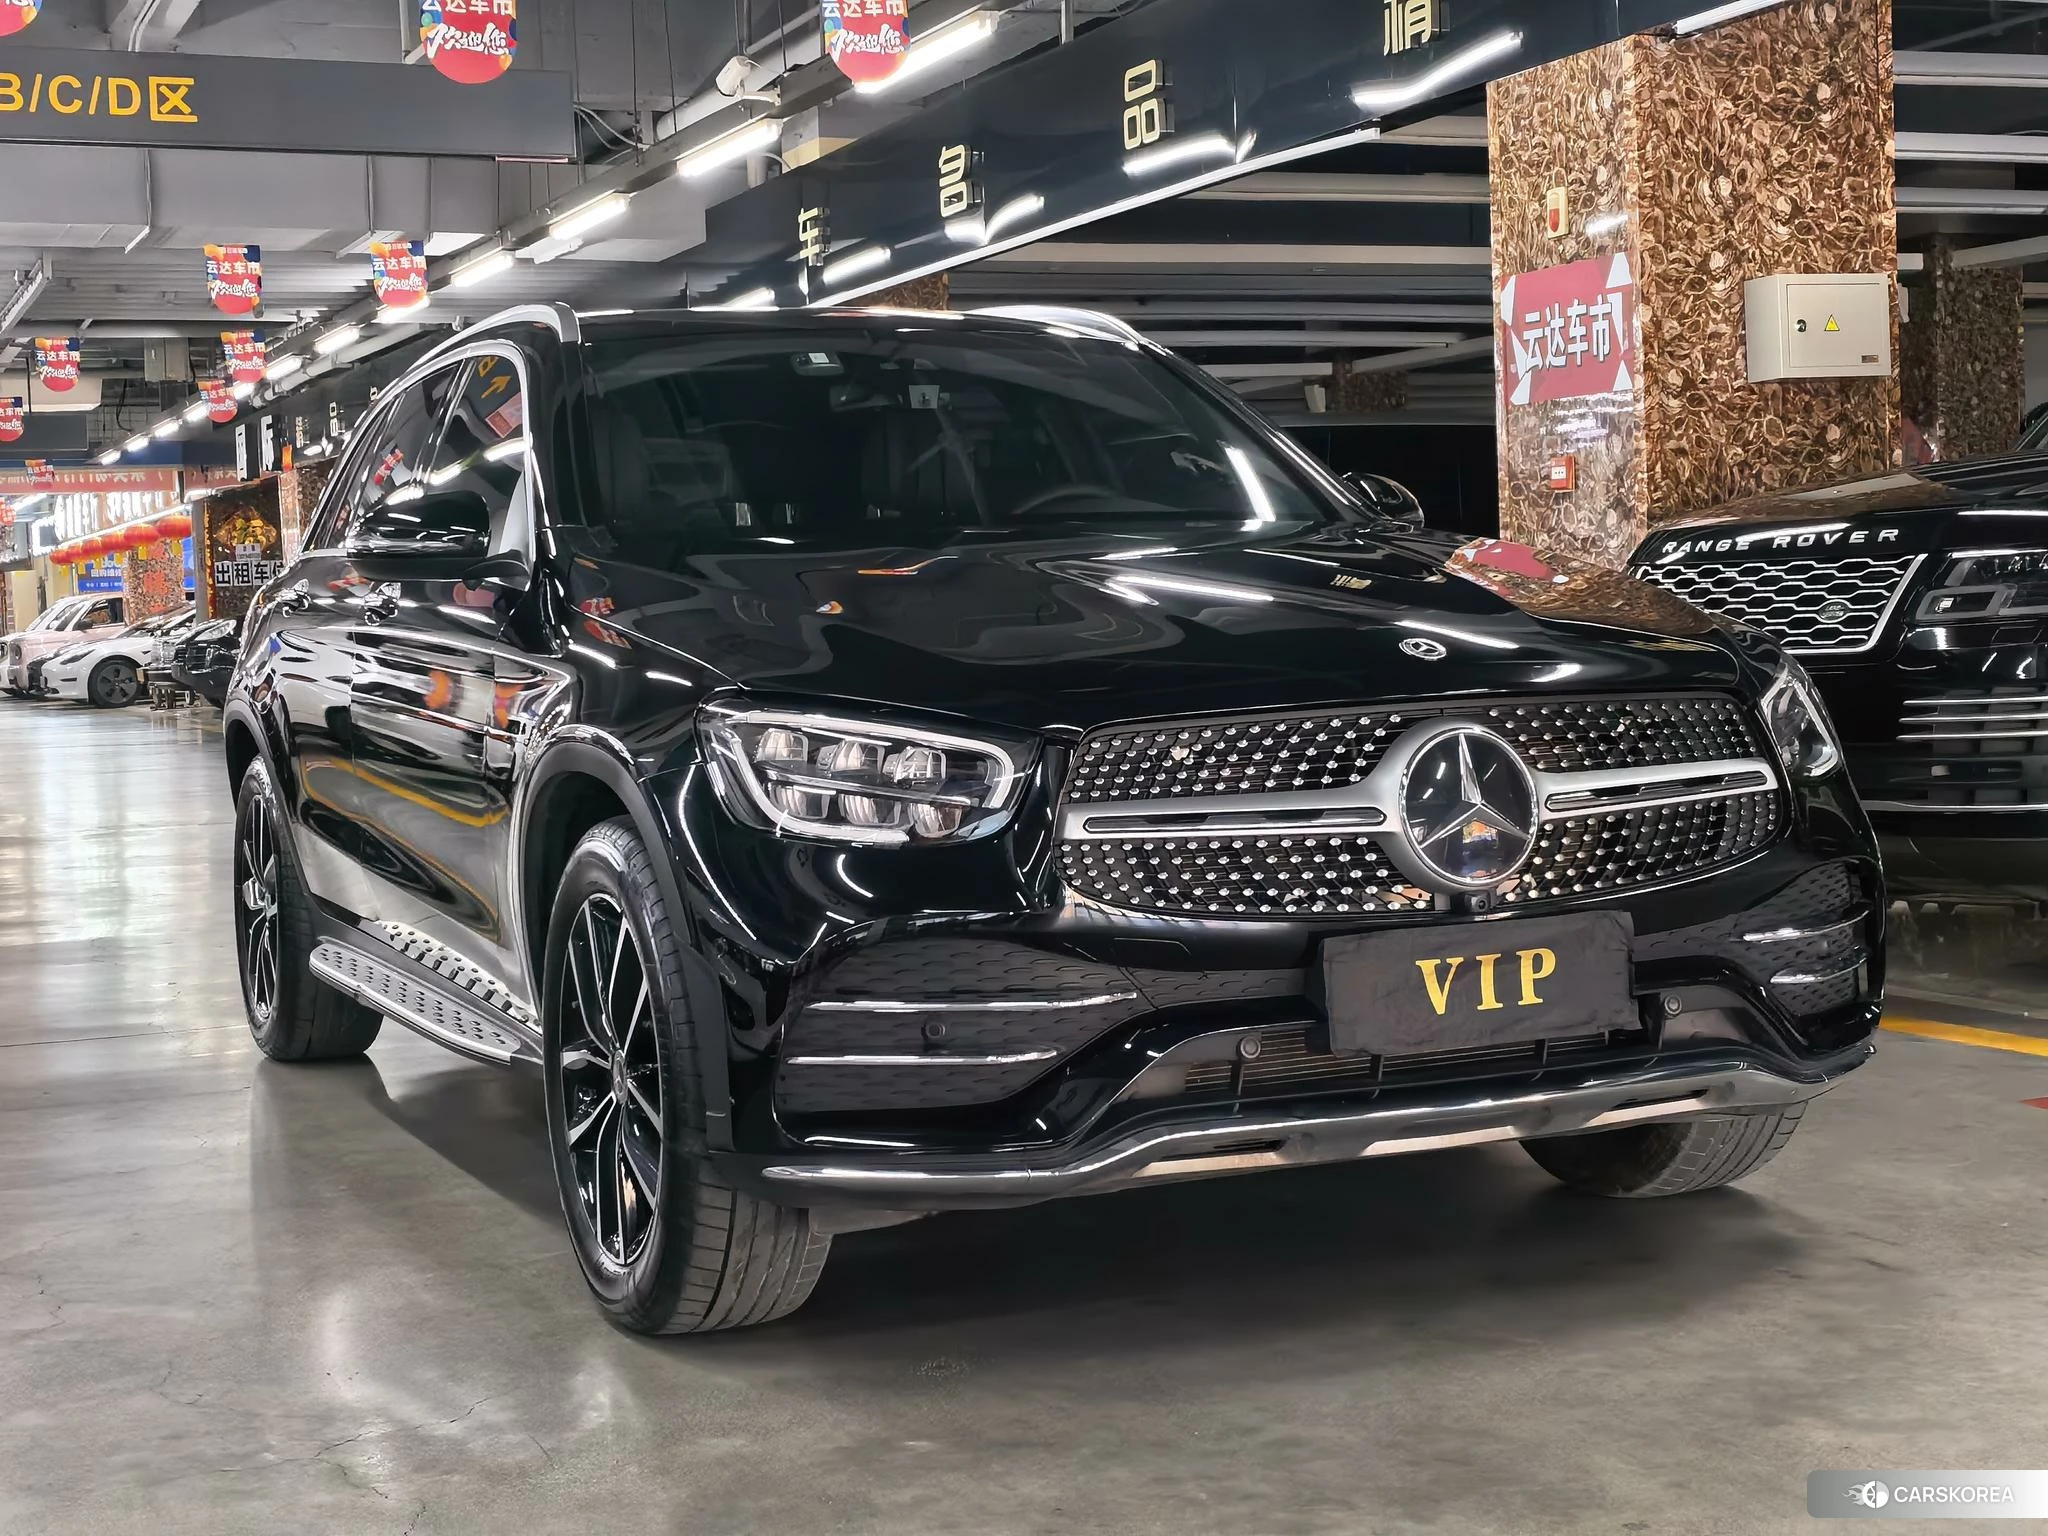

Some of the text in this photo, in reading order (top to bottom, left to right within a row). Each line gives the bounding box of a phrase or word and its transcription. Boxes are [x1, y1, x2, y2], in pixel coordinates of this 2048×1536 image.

[0, 72, 199, 123] B/C/D区
[206, 260, 262, 275] 云达车市
[373, 255, 427, 271] 云达车市
[1522, 294, 1613, 373] 云达车市
[1661, 528, 1900, 554] RANGE ROVER
[1415, 948, 1556, 1015] VIP
